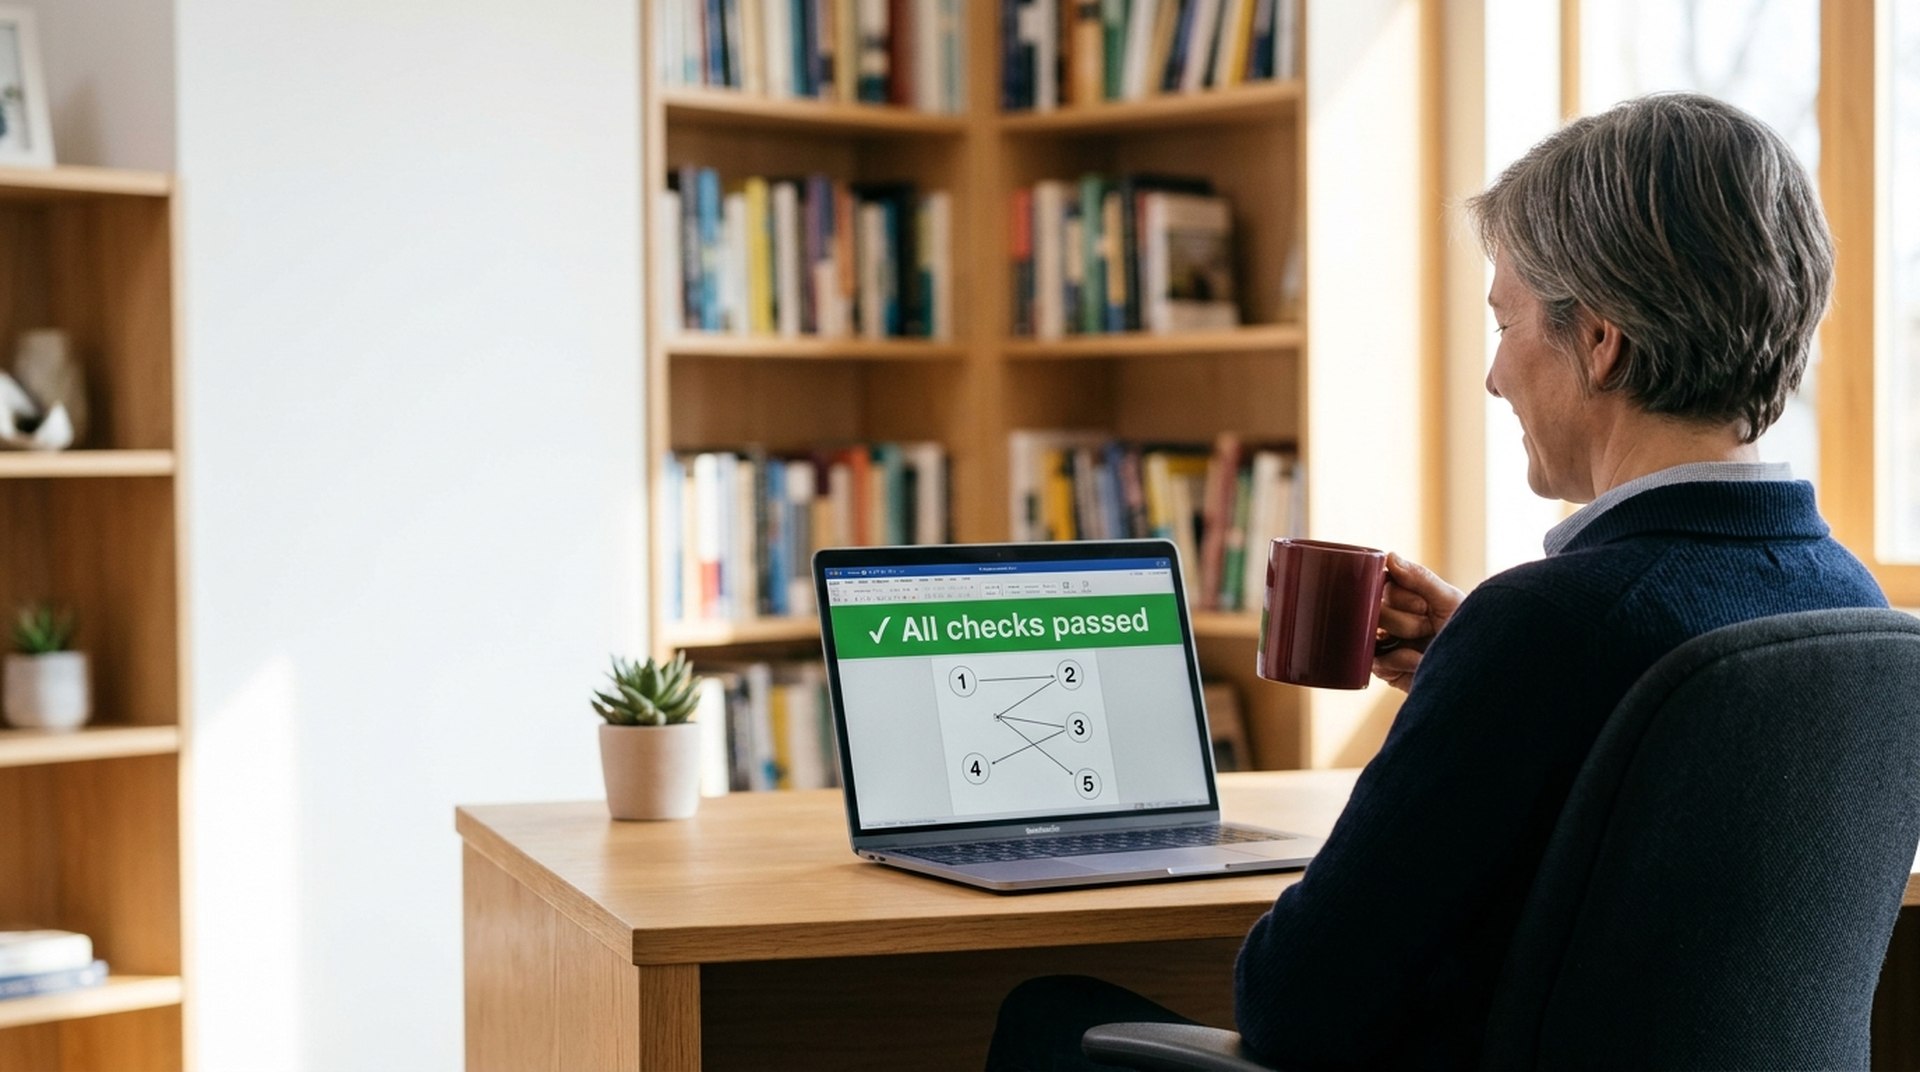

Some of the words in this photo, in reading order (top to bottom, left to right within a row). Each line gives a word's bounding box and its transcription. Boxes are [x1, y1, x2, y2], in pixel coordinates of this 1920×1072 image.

[902, 615, 938, 642] All
[946, 612, 1045, 641] checks
[1052, 606, 1149, 642] passed
[957, 674, 967, 690] 1
[1064, 667, 1077, 683] 2
[1073, 720, 1085, 736] 3
[970, 760, 982, 777] 4
[1083, 776, 1095, 792] 5
